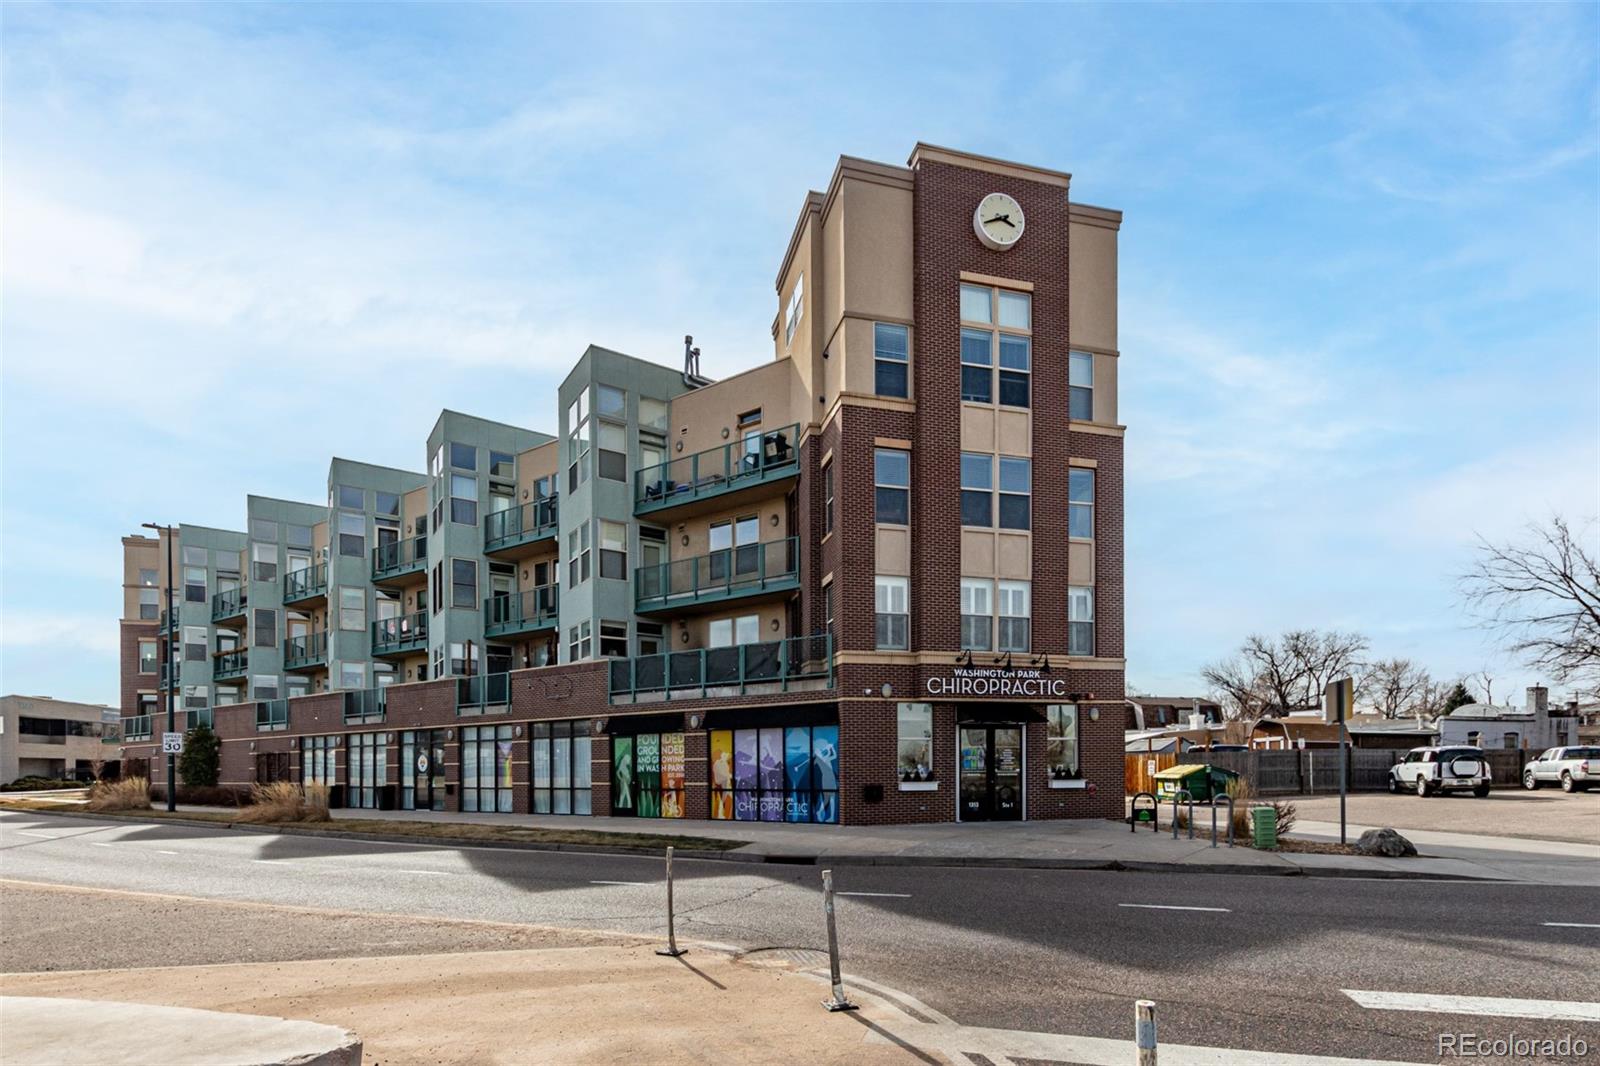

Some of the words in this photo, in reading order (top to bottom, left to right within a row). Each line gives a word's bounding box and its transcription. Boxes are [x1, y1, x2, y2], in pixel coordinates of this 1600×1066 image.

[954, 668, 1015, 678] WASHINGTON
[1017, 670, 1041, 679] PARK
[927, 677, 1066, 696] CHIROPRACTIC
[165, 743, 181, 751] 30
[637, 764, 644, 772] IN
[645, 764, 667, 772] WASH
[668, 763, 685, 772] PARK
